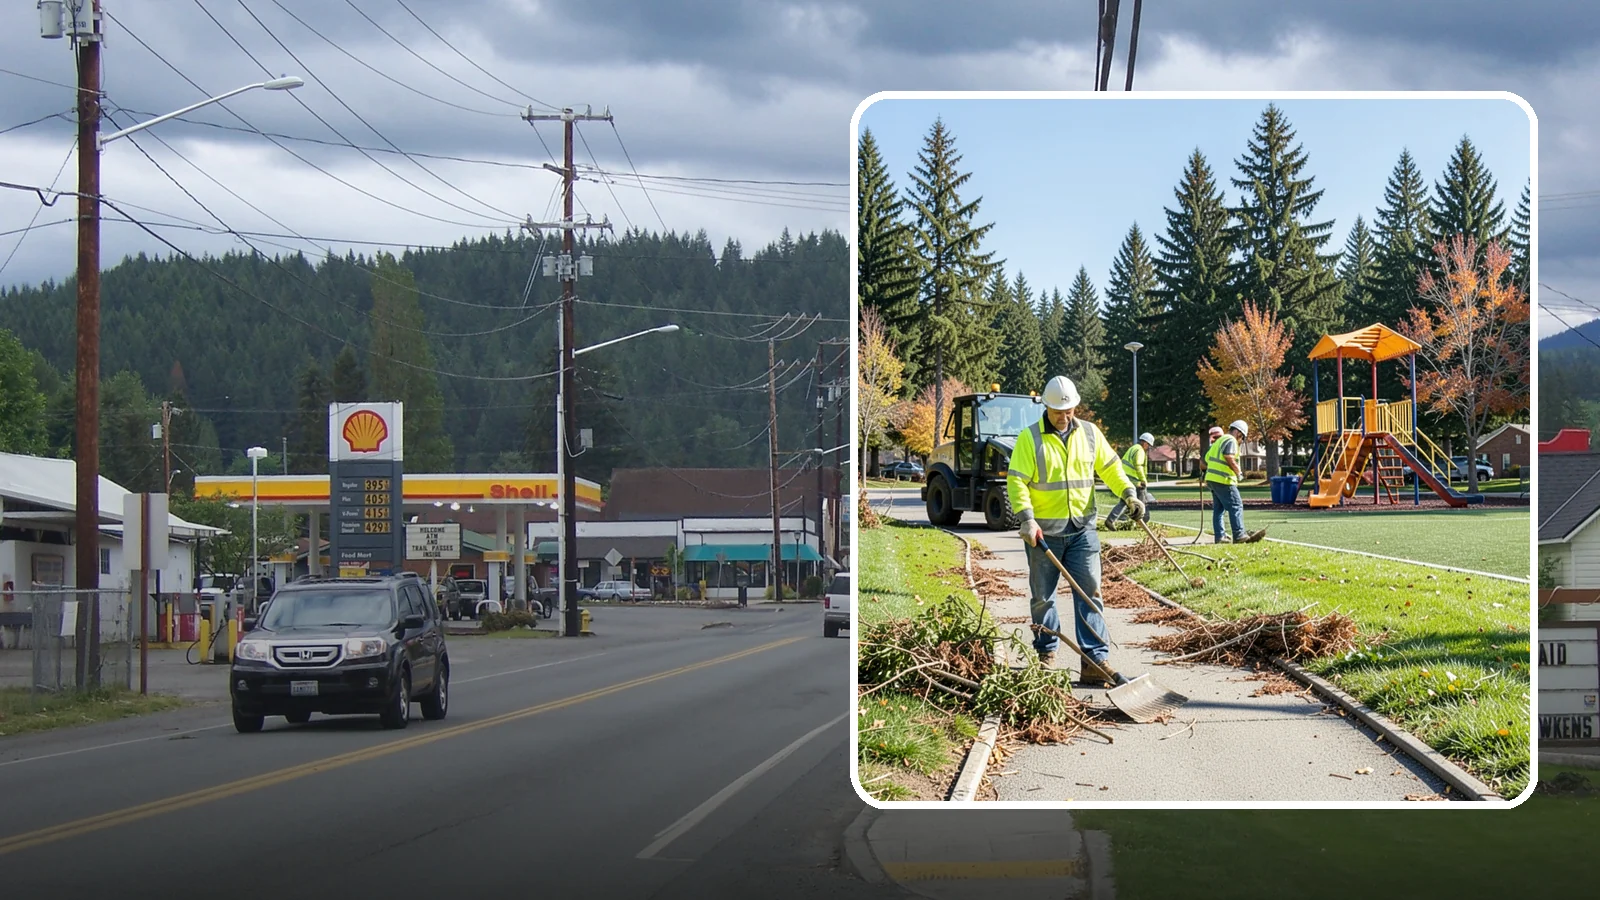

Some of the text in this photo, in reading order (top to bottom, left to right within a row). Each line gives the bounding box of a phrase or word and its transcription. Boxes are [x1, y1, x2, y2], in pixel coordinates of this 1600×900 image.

[366, 480, 383, 490] 395
[490, 484, 547, 498] Shell
[366, 494, 383, 504] 405
[366, 508, 383, 518] 415
[366, 522, 383, 532] 429
